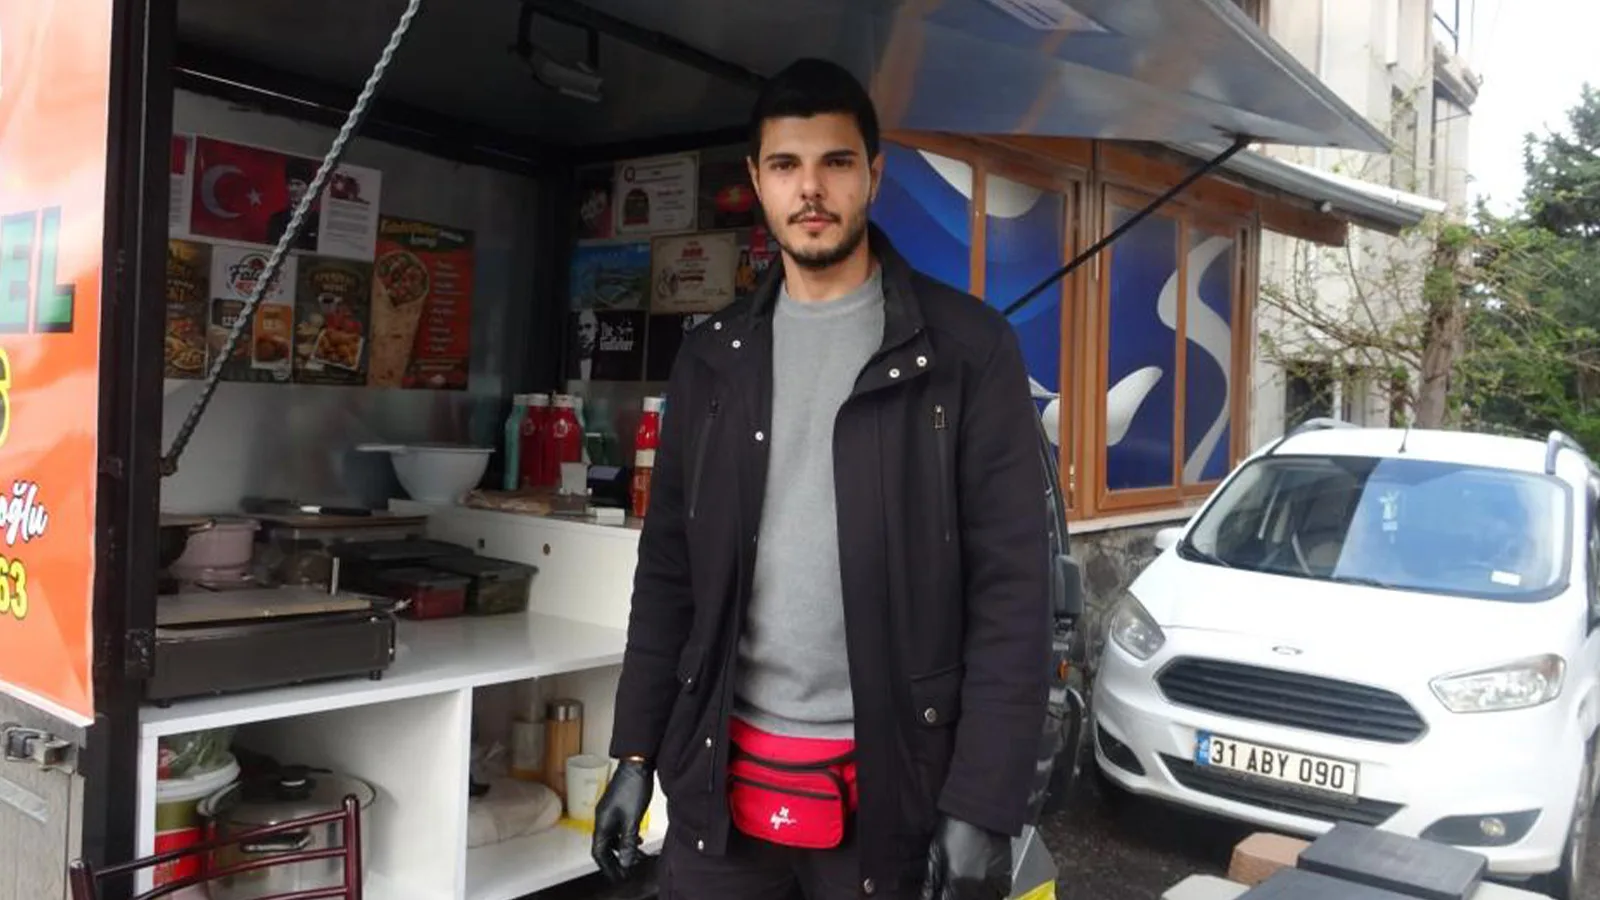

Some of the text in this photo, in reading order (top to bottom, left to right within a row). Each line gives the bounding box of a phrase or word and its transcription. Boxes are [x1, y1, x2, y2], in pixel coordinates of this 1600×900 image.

[1211, 740, 1236, 767] 31
[1246, 747, 1289, 778] ABY
[1299, 758, 1345, 789] 090
